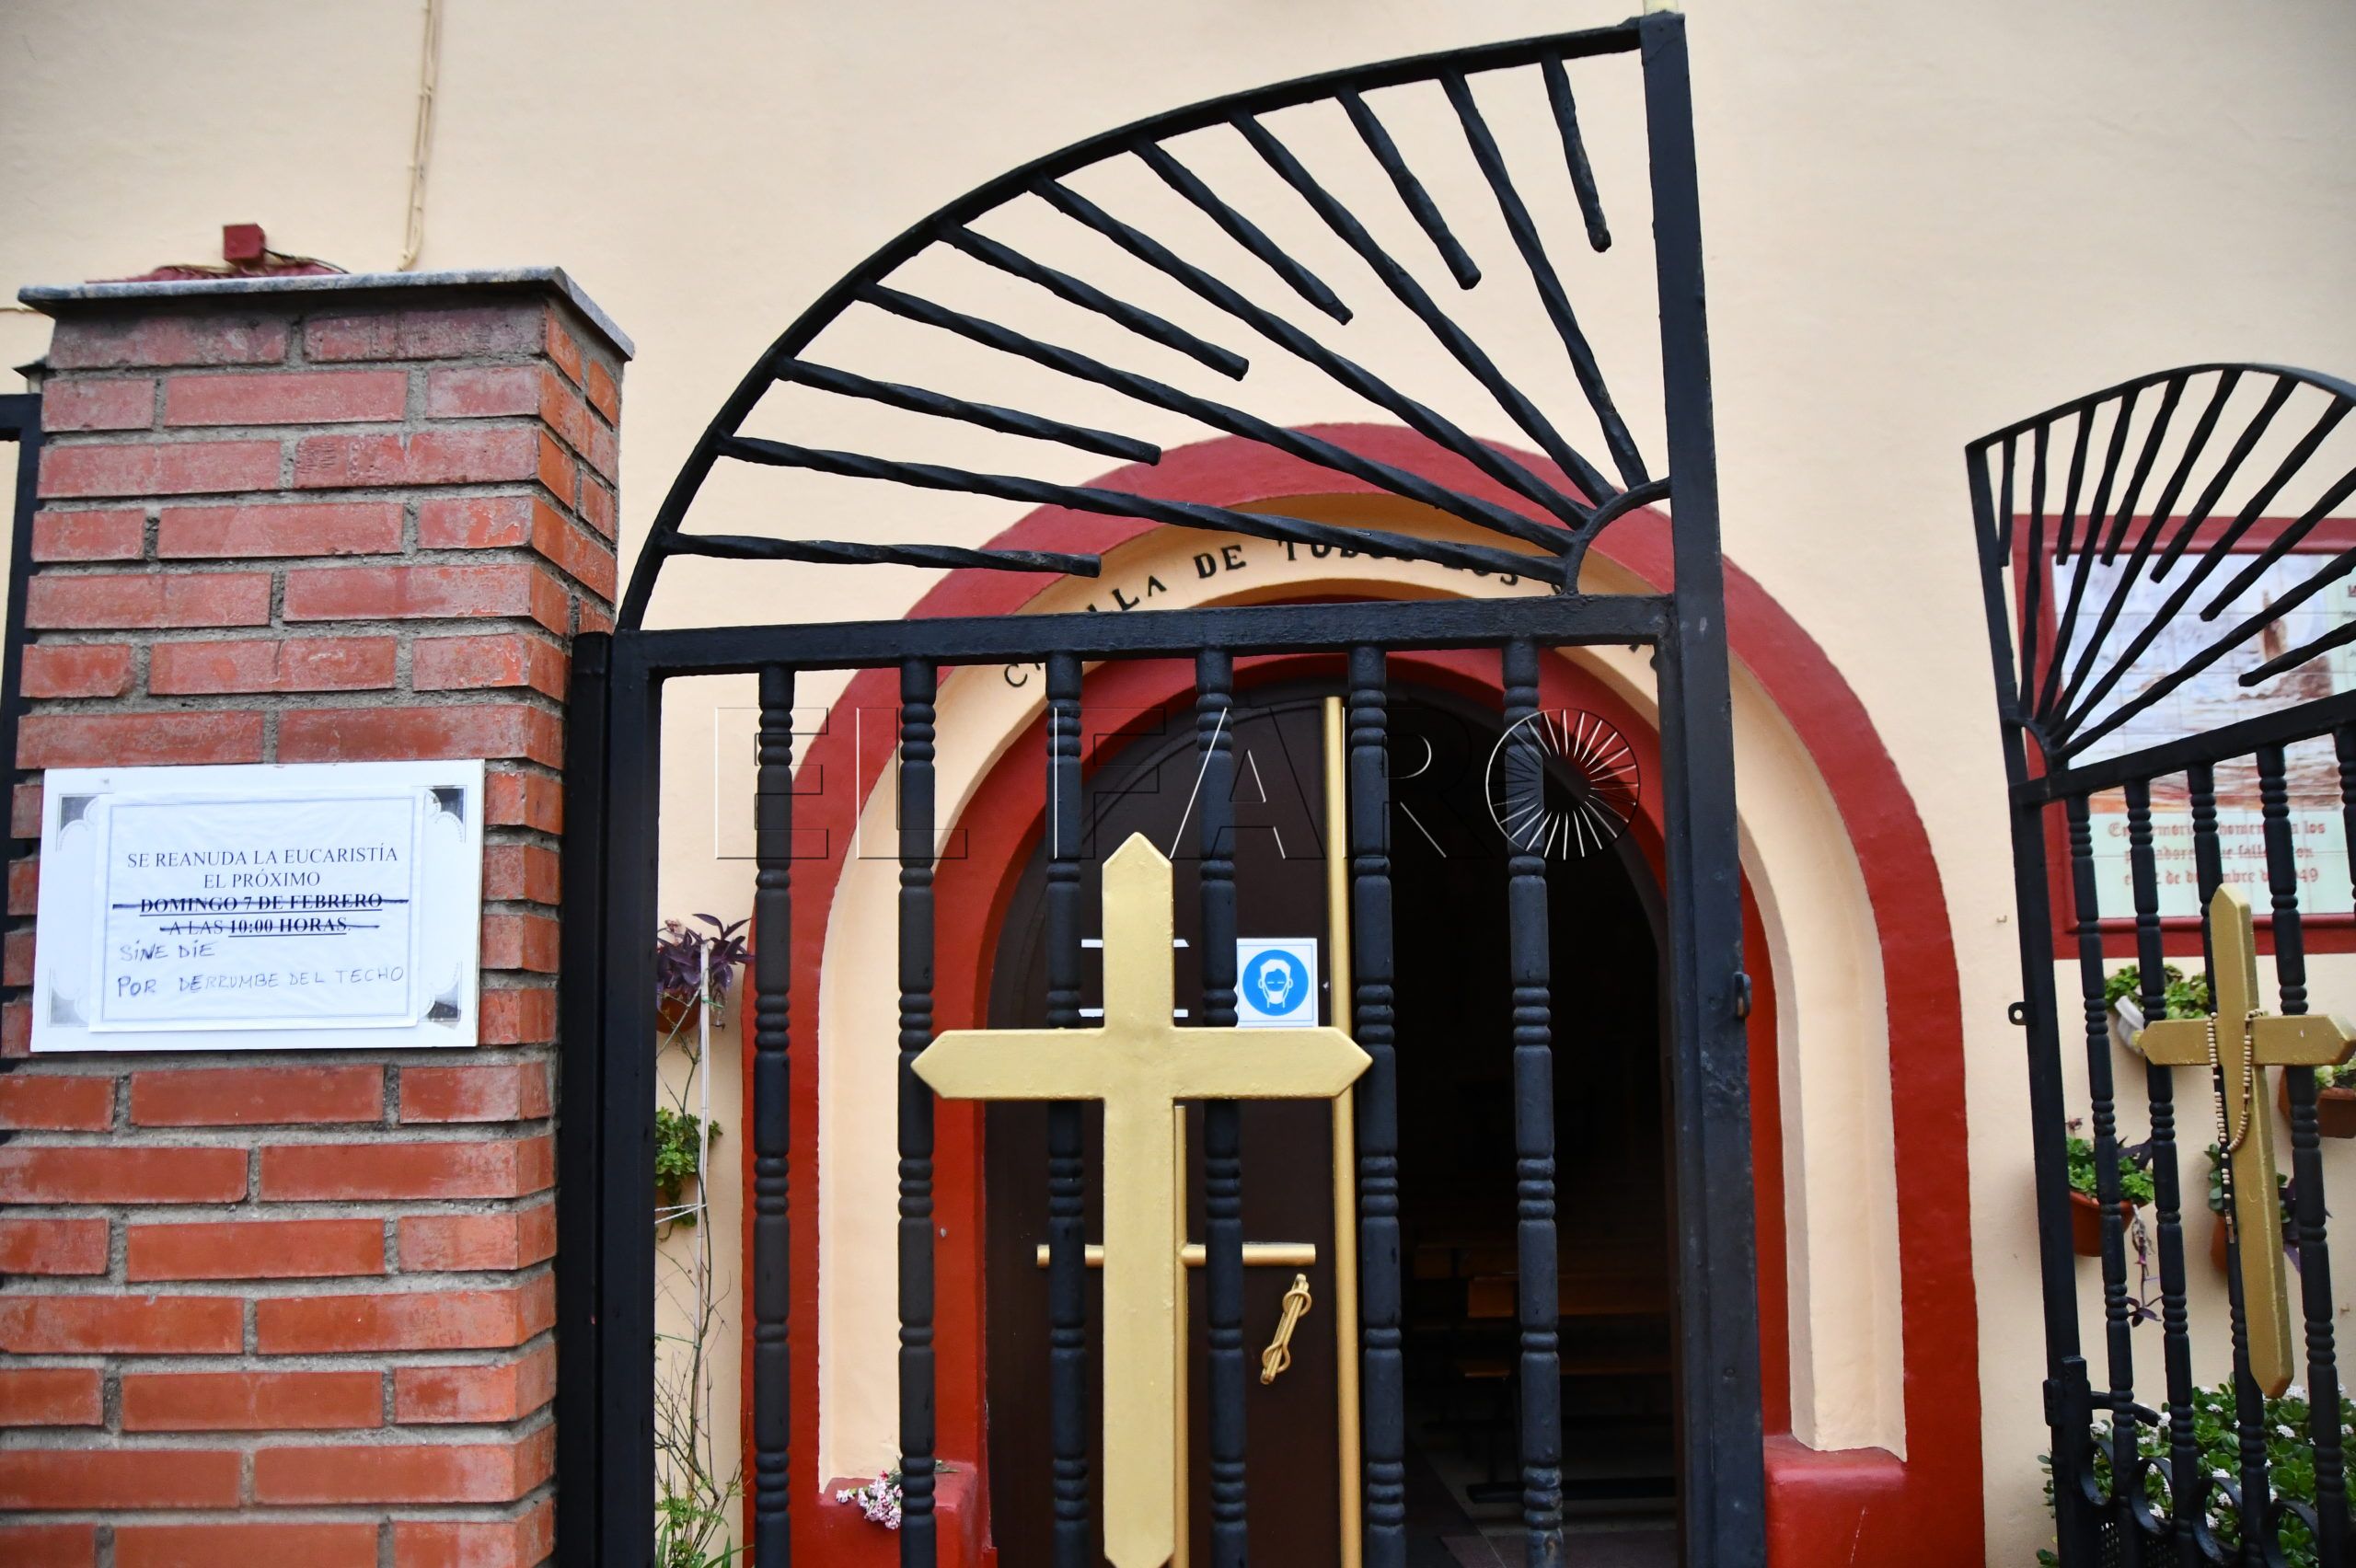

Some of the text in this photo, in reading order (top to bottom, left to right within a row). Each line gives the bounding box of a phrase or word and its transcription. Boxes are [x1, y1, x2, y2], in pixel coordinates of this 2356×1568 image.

[1193, 544, 1247, 579] DE
[2304, 821, 2327, 835] los
[127, 842, 398, 868] SE REANUDA LA EUCARISTÍA
[203, 869, 320, 889] EL PRÓXIMO
[140, 893, 383, 913] DOMINGO 7 DE FEBRERO
[169, 921, 181, 935] A
[189, 920, 224, 935] LAS
[230, 919, 273, 935] 10:00
[117, 966, 404, 997] POR DERRUMBE DEL TECHO
